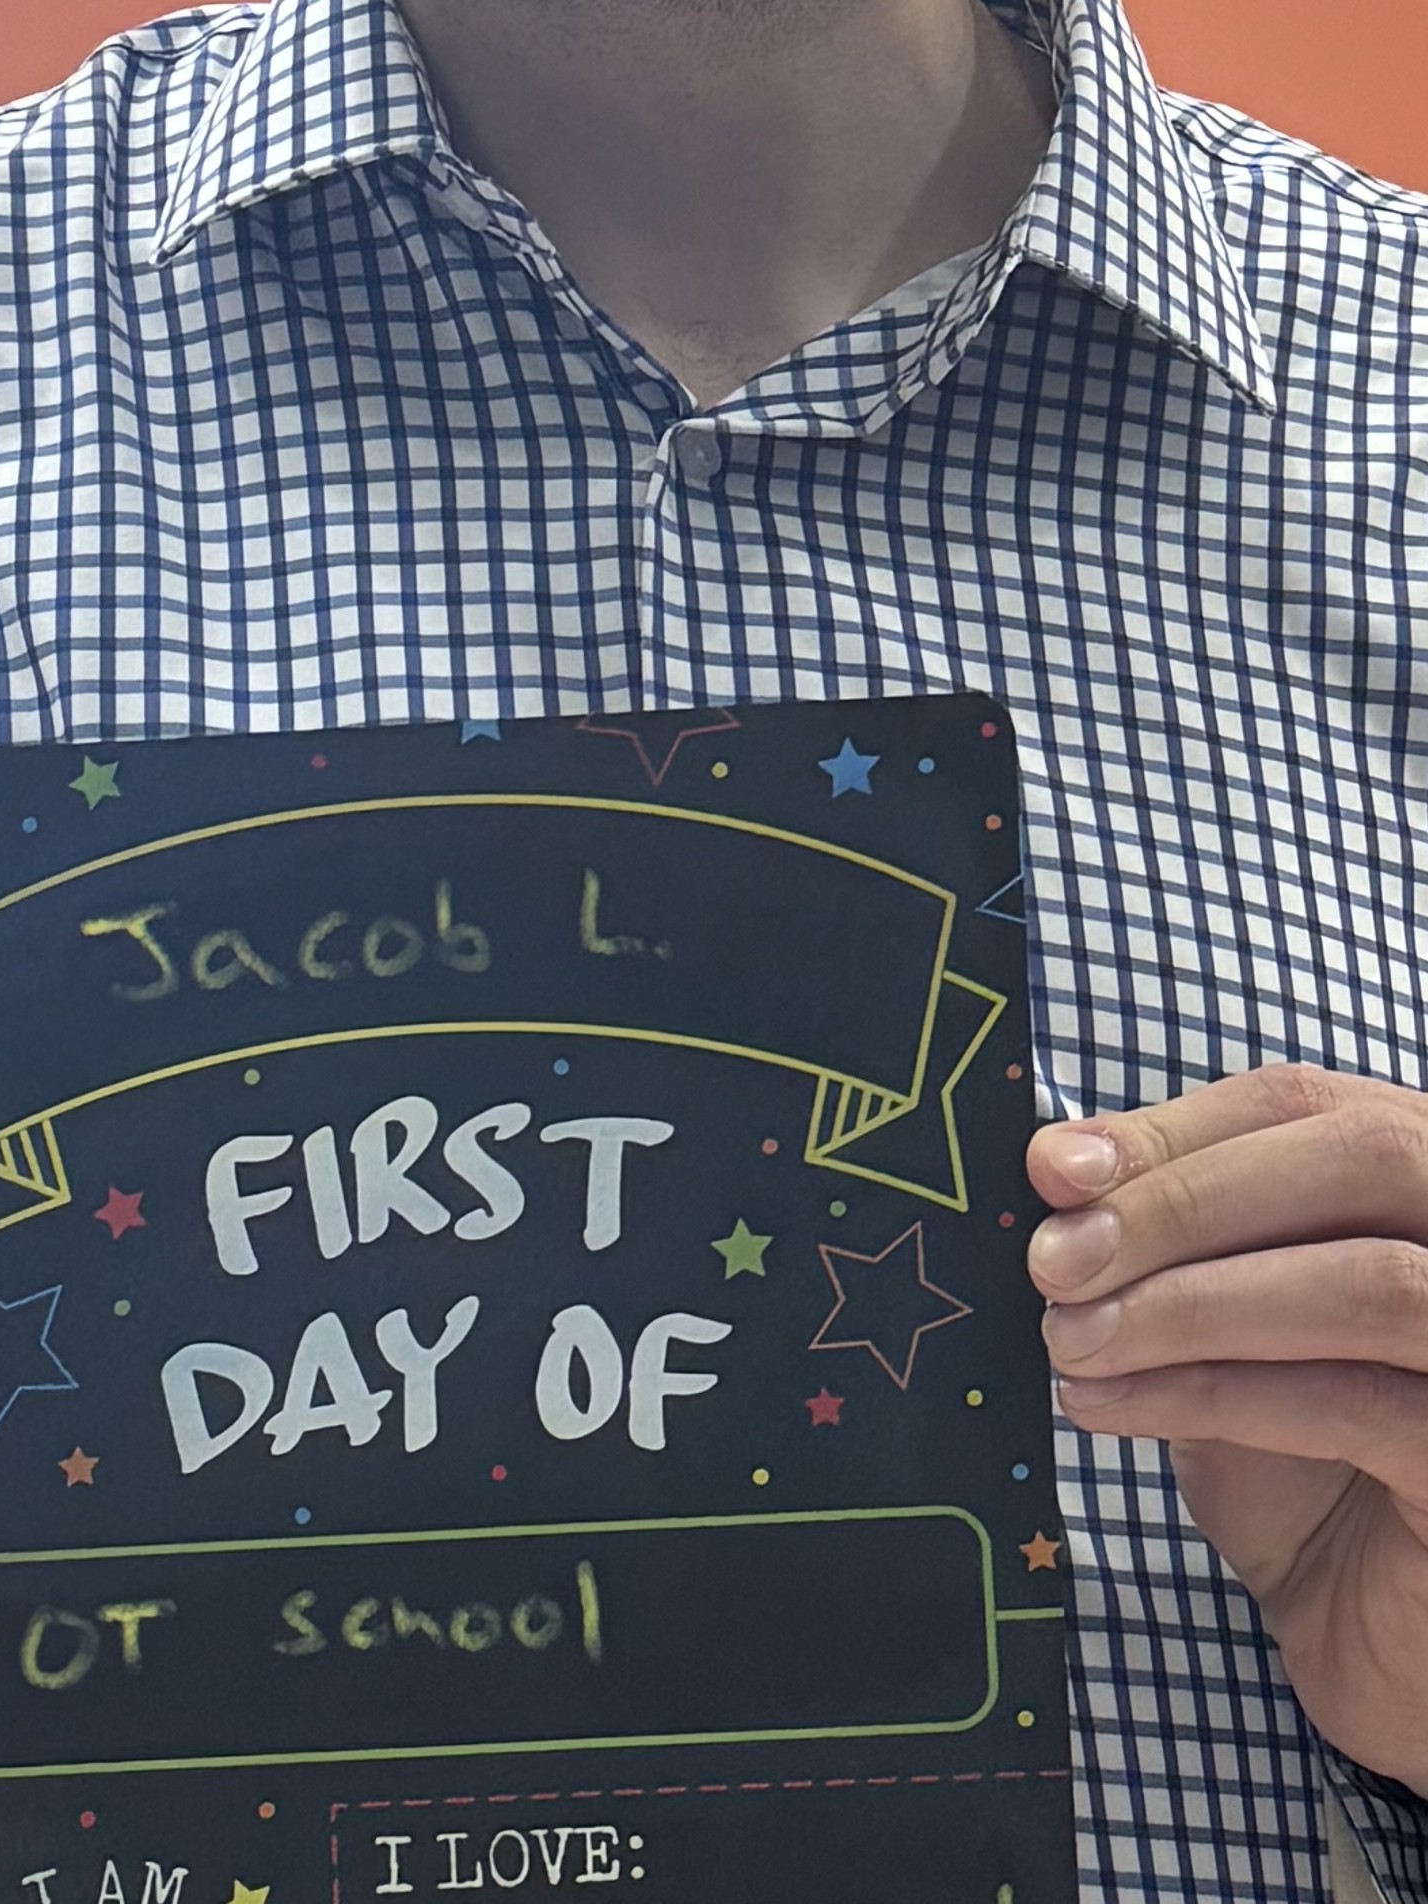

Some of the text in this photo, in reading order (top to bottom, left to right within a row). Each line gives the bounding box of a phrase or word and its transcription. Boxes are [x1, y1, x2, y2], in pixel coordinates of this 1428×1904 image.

[79, 878, 492, 1000] Jacob
[206, 1095, 674, 1275] FIRST
[161, 1295, 732, 1474] DAY OF
[20, 1604, 176, 1689] OT
[375, 1826, 646, 1894] I LOVE:
